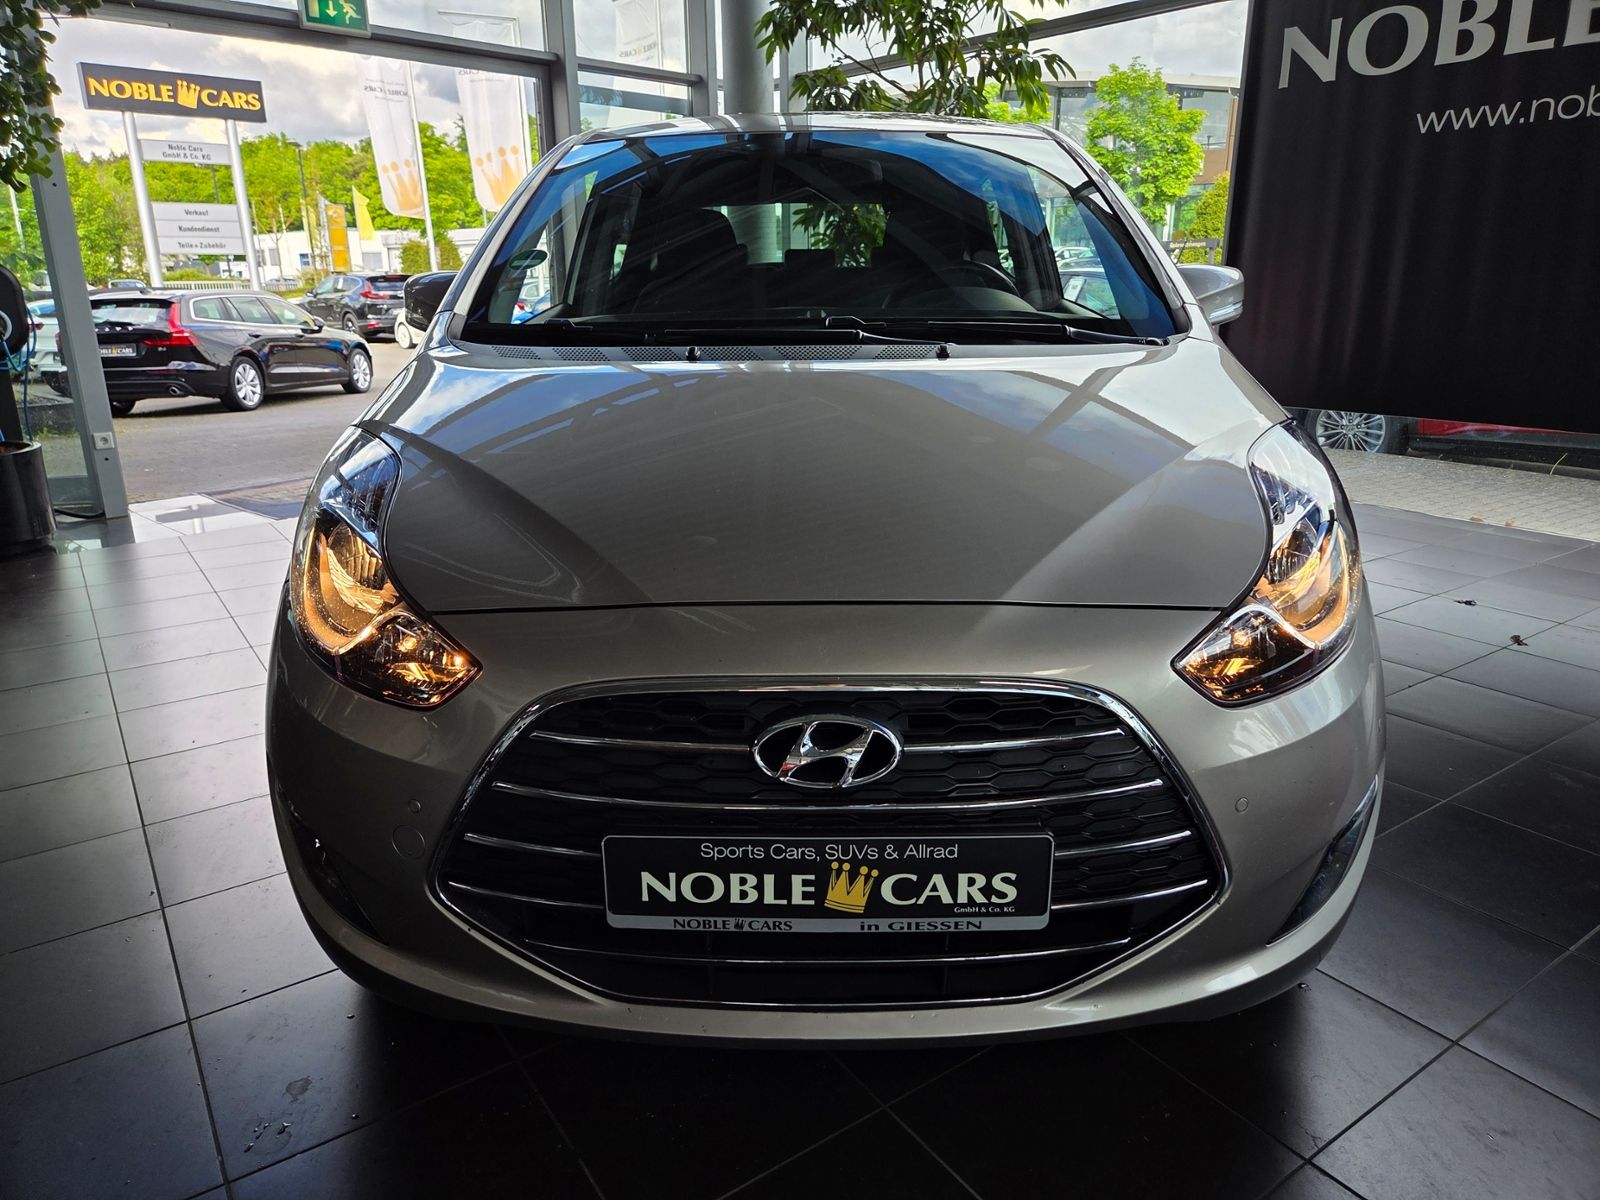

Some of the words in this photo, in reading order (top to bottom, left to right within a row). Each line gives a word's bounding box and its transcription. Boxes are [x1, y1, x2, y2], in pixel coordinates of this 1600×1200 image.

[87, 76, 175, 103] NOBLE
[201, 89, 261, 111] CARS
[201, 153, 212, 161] KG
[178, 225, 220, 233] Kundendienst
[700, 843, 765, 861] Sports
[770, 843, 820, 862] Cars,
[825, 844, 879, 860] SUVs
[884, 844, 899, 860] &
[903, 844, 959, 859] Allrad
[641, 871, 816, 905] NOBLE
[880, 872, 1018, 906] CARS
[673, 918, 731, 930] NOBLE
[748, 920, 793, 931] CARS
[860, 921, 880, 931] in
[887, 920, 982, 931] GIESSEN
